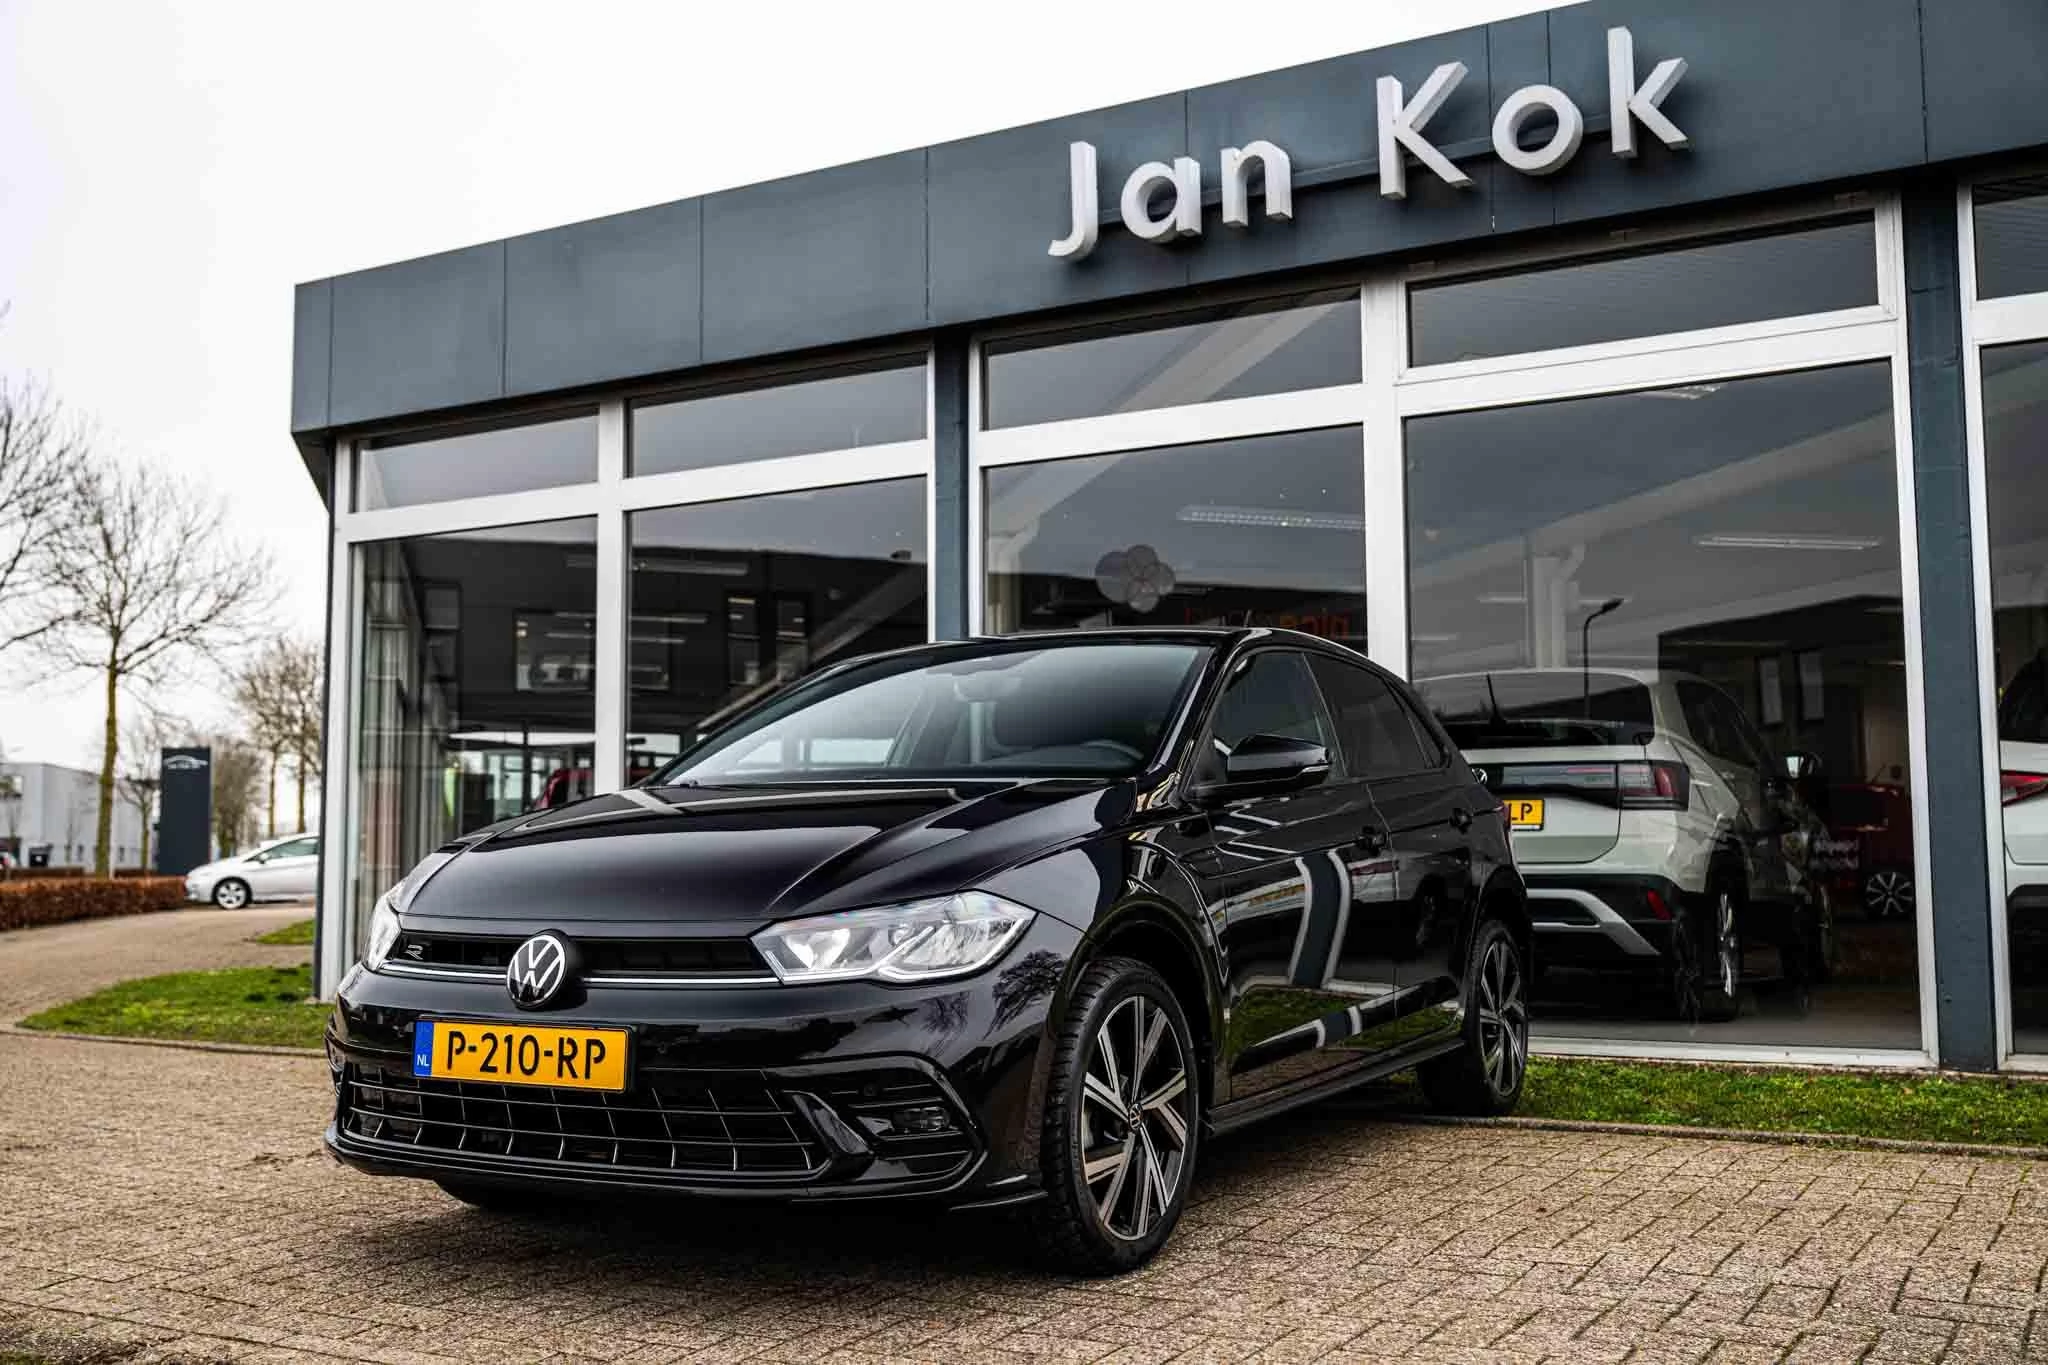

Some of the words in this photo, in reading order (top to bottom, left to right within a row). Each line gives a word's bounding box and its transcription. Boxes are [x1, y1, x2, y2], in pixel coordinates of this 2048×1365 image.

[1048, 140, 1293, 262] Jan
[1376, 26, 1689, 199] Kok
[416, 1054, 430, 1067] NL
[447, 1030, 606, 1080] P-210-RP
